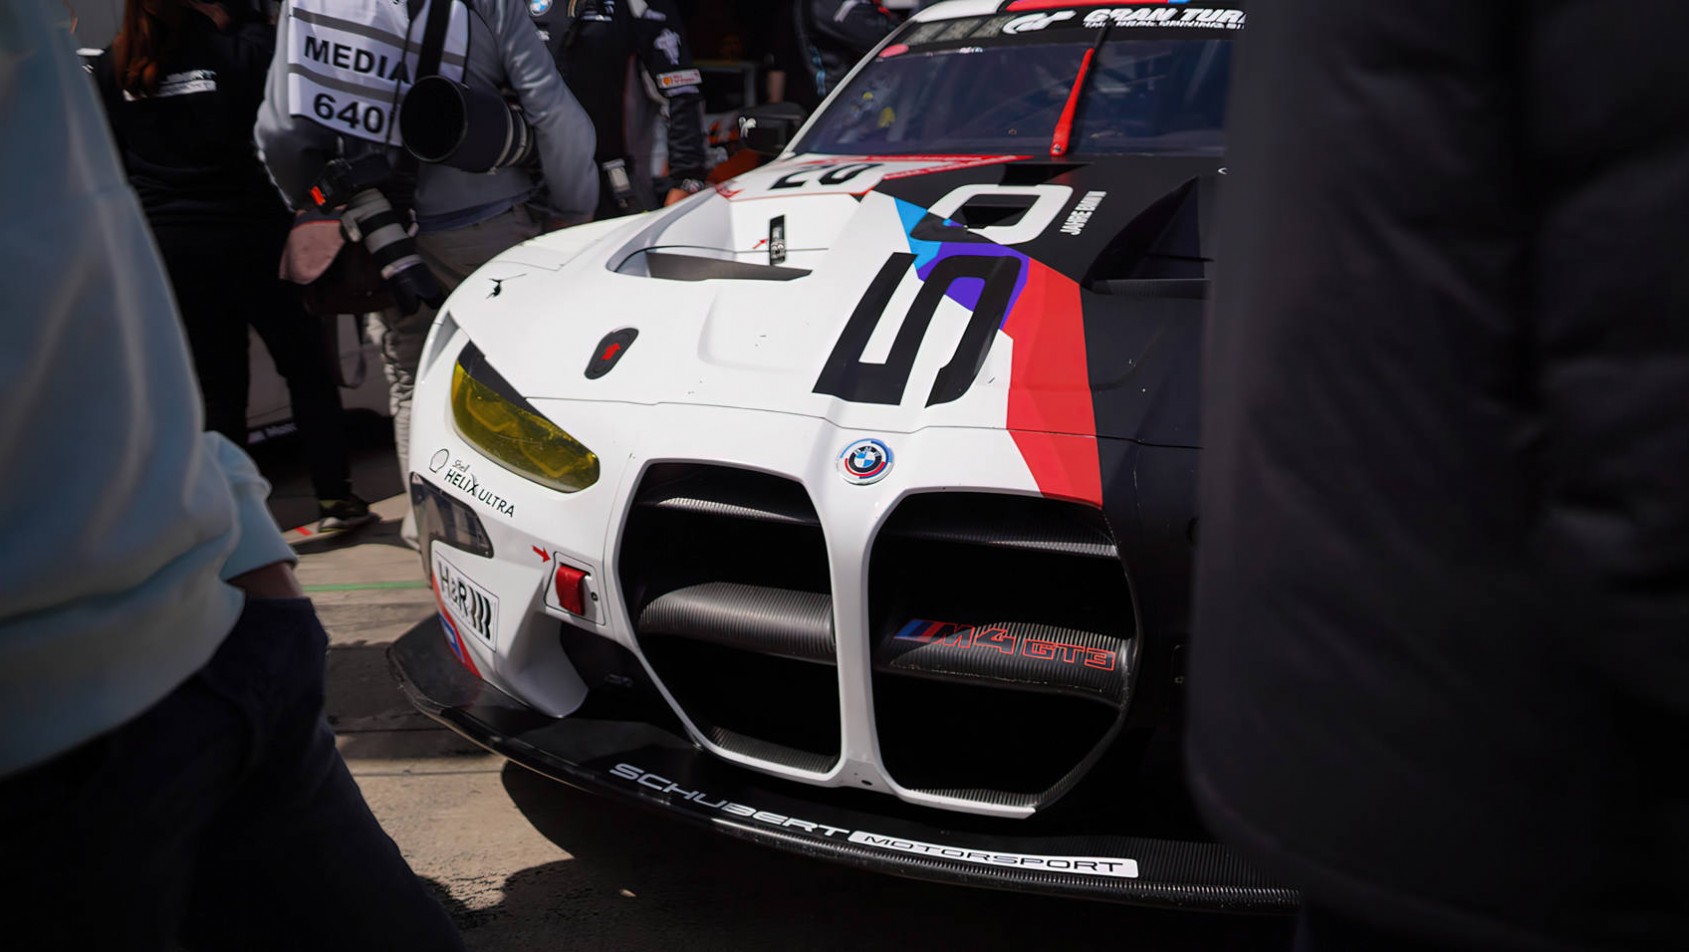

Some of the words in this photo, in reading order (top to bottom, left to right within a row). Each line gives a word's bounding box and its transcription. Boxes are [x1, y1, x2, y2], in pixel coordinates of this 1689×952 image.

[1083, 8, 1178, 22] GRAN
[1180, 8, 1247, 24] TUR
[304, 35, 413, 86] MEDIA
[313, 93, 385, 134] 640
[767, 163, 884, 190] 20
[444, 469, 480, 497] HELIX
[478, 489, 514, 518] ULTRA
[1022, 638, 1116, 671] GT3
[609, 763, 850, 837] SCHUBERT
[864, 835, 1124, 874] MOTORSPORT
